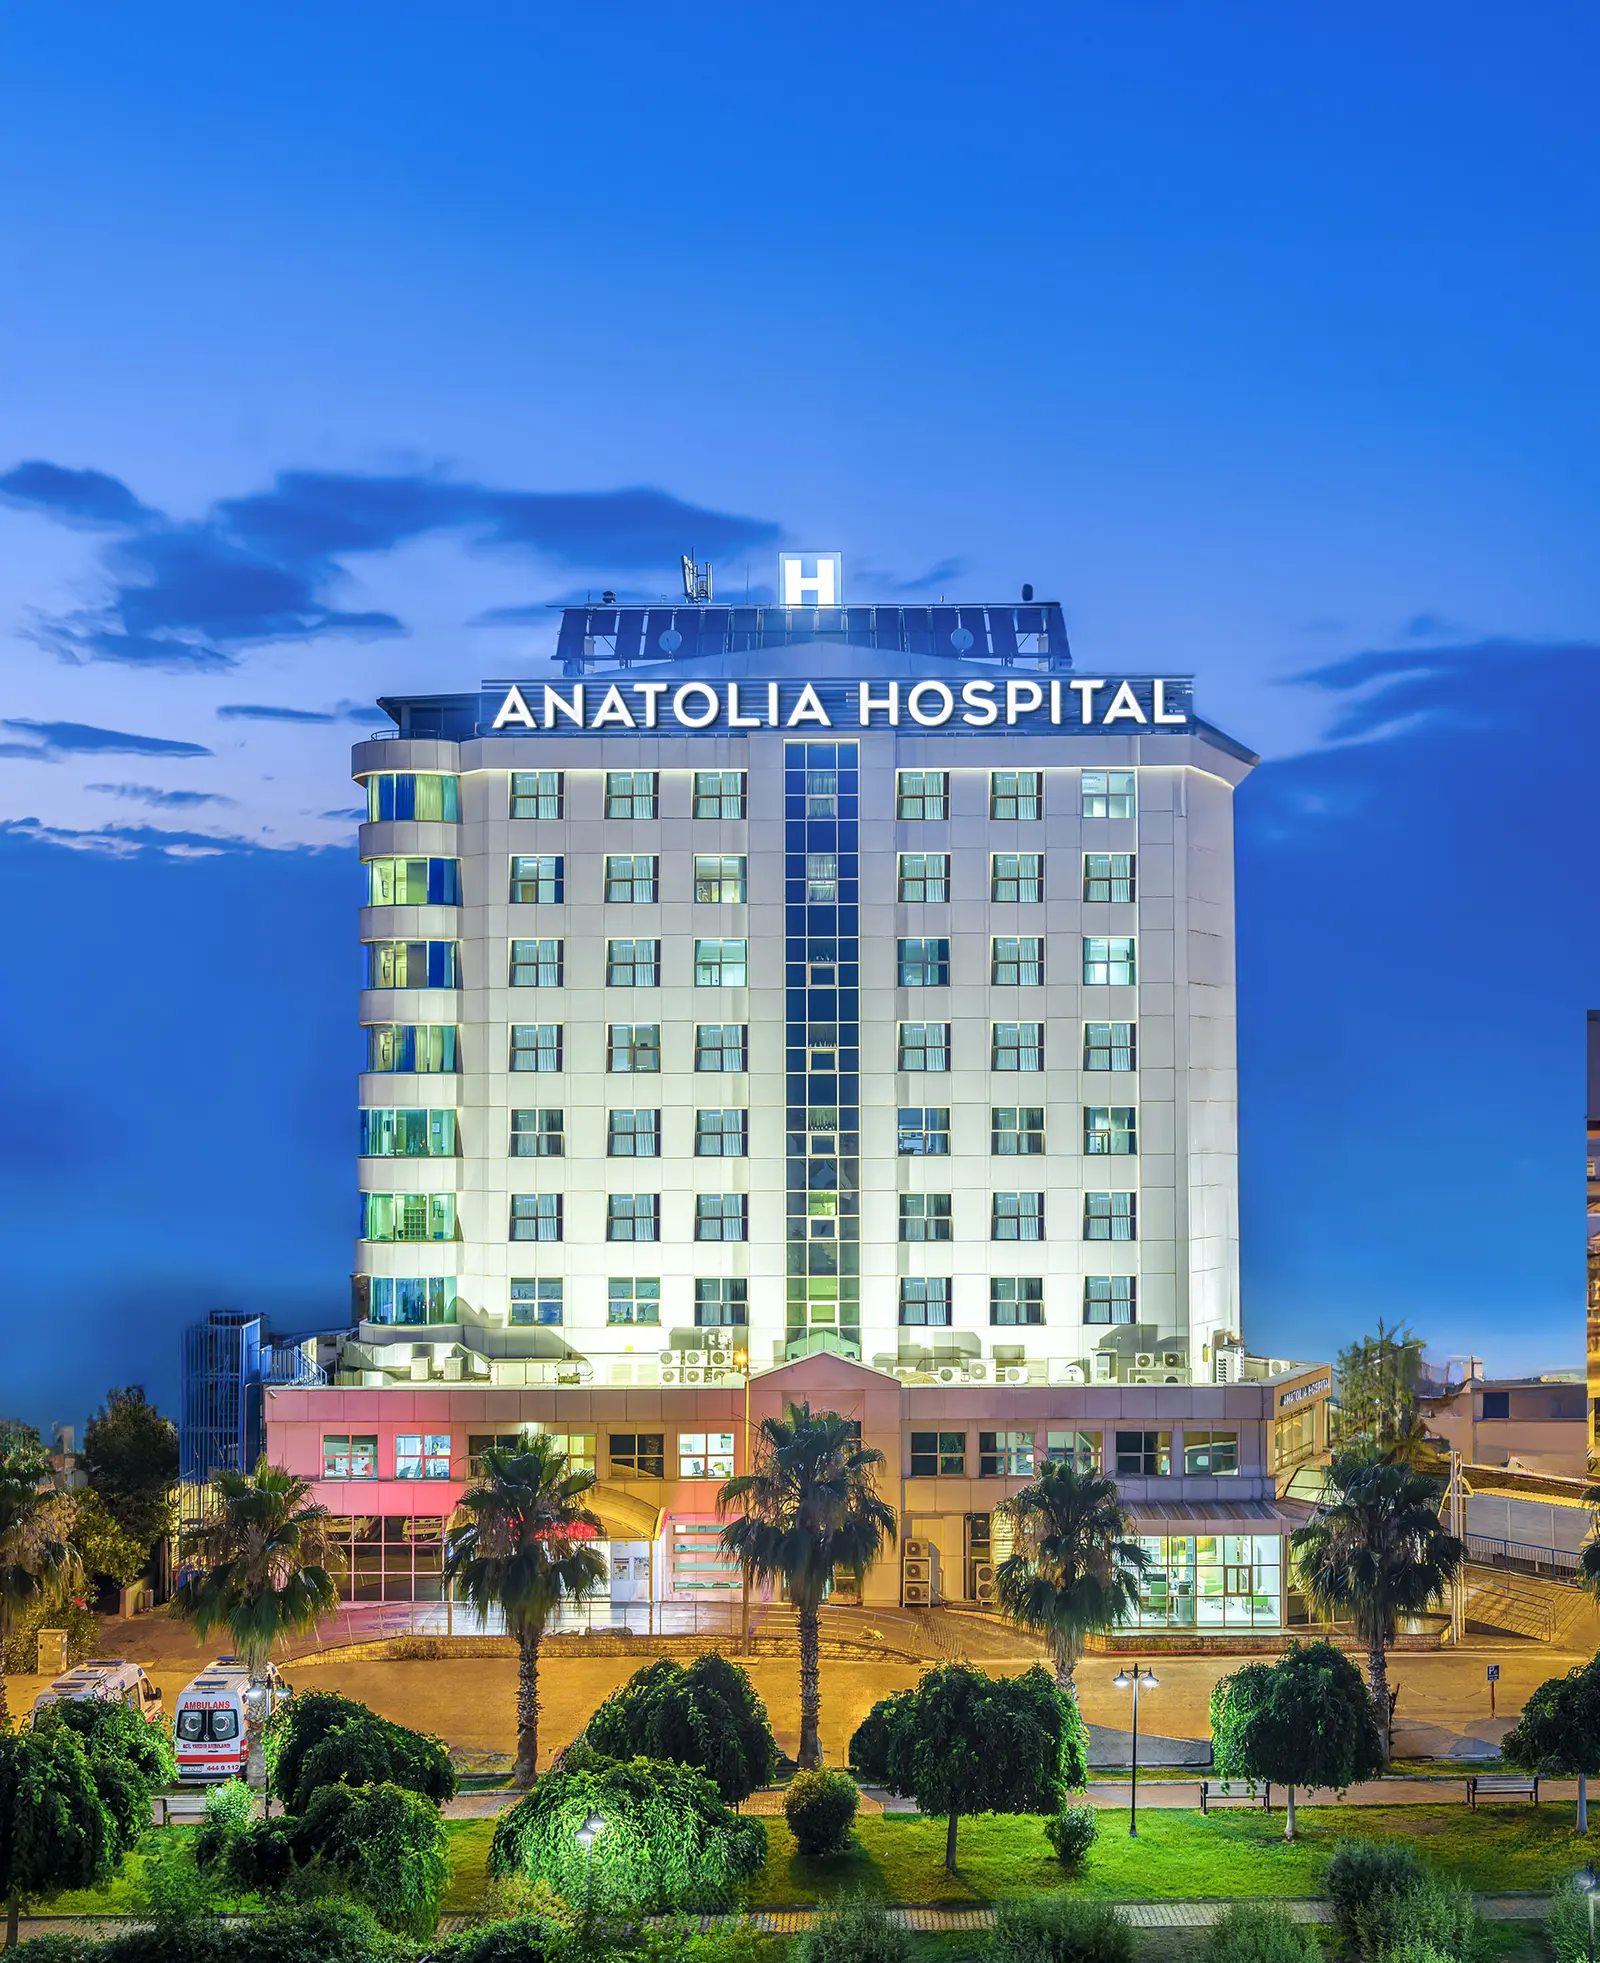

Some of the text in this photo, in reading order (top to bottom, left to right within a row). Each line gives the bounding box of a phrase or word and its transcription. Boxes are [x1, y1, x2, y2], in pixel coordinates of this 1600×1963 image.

[785, 559, 834, 609] H
[492, 678, 1188, 728] ANATOLIA HOSPITAL
[184, 1701, 230, 1709] AMBULANS
